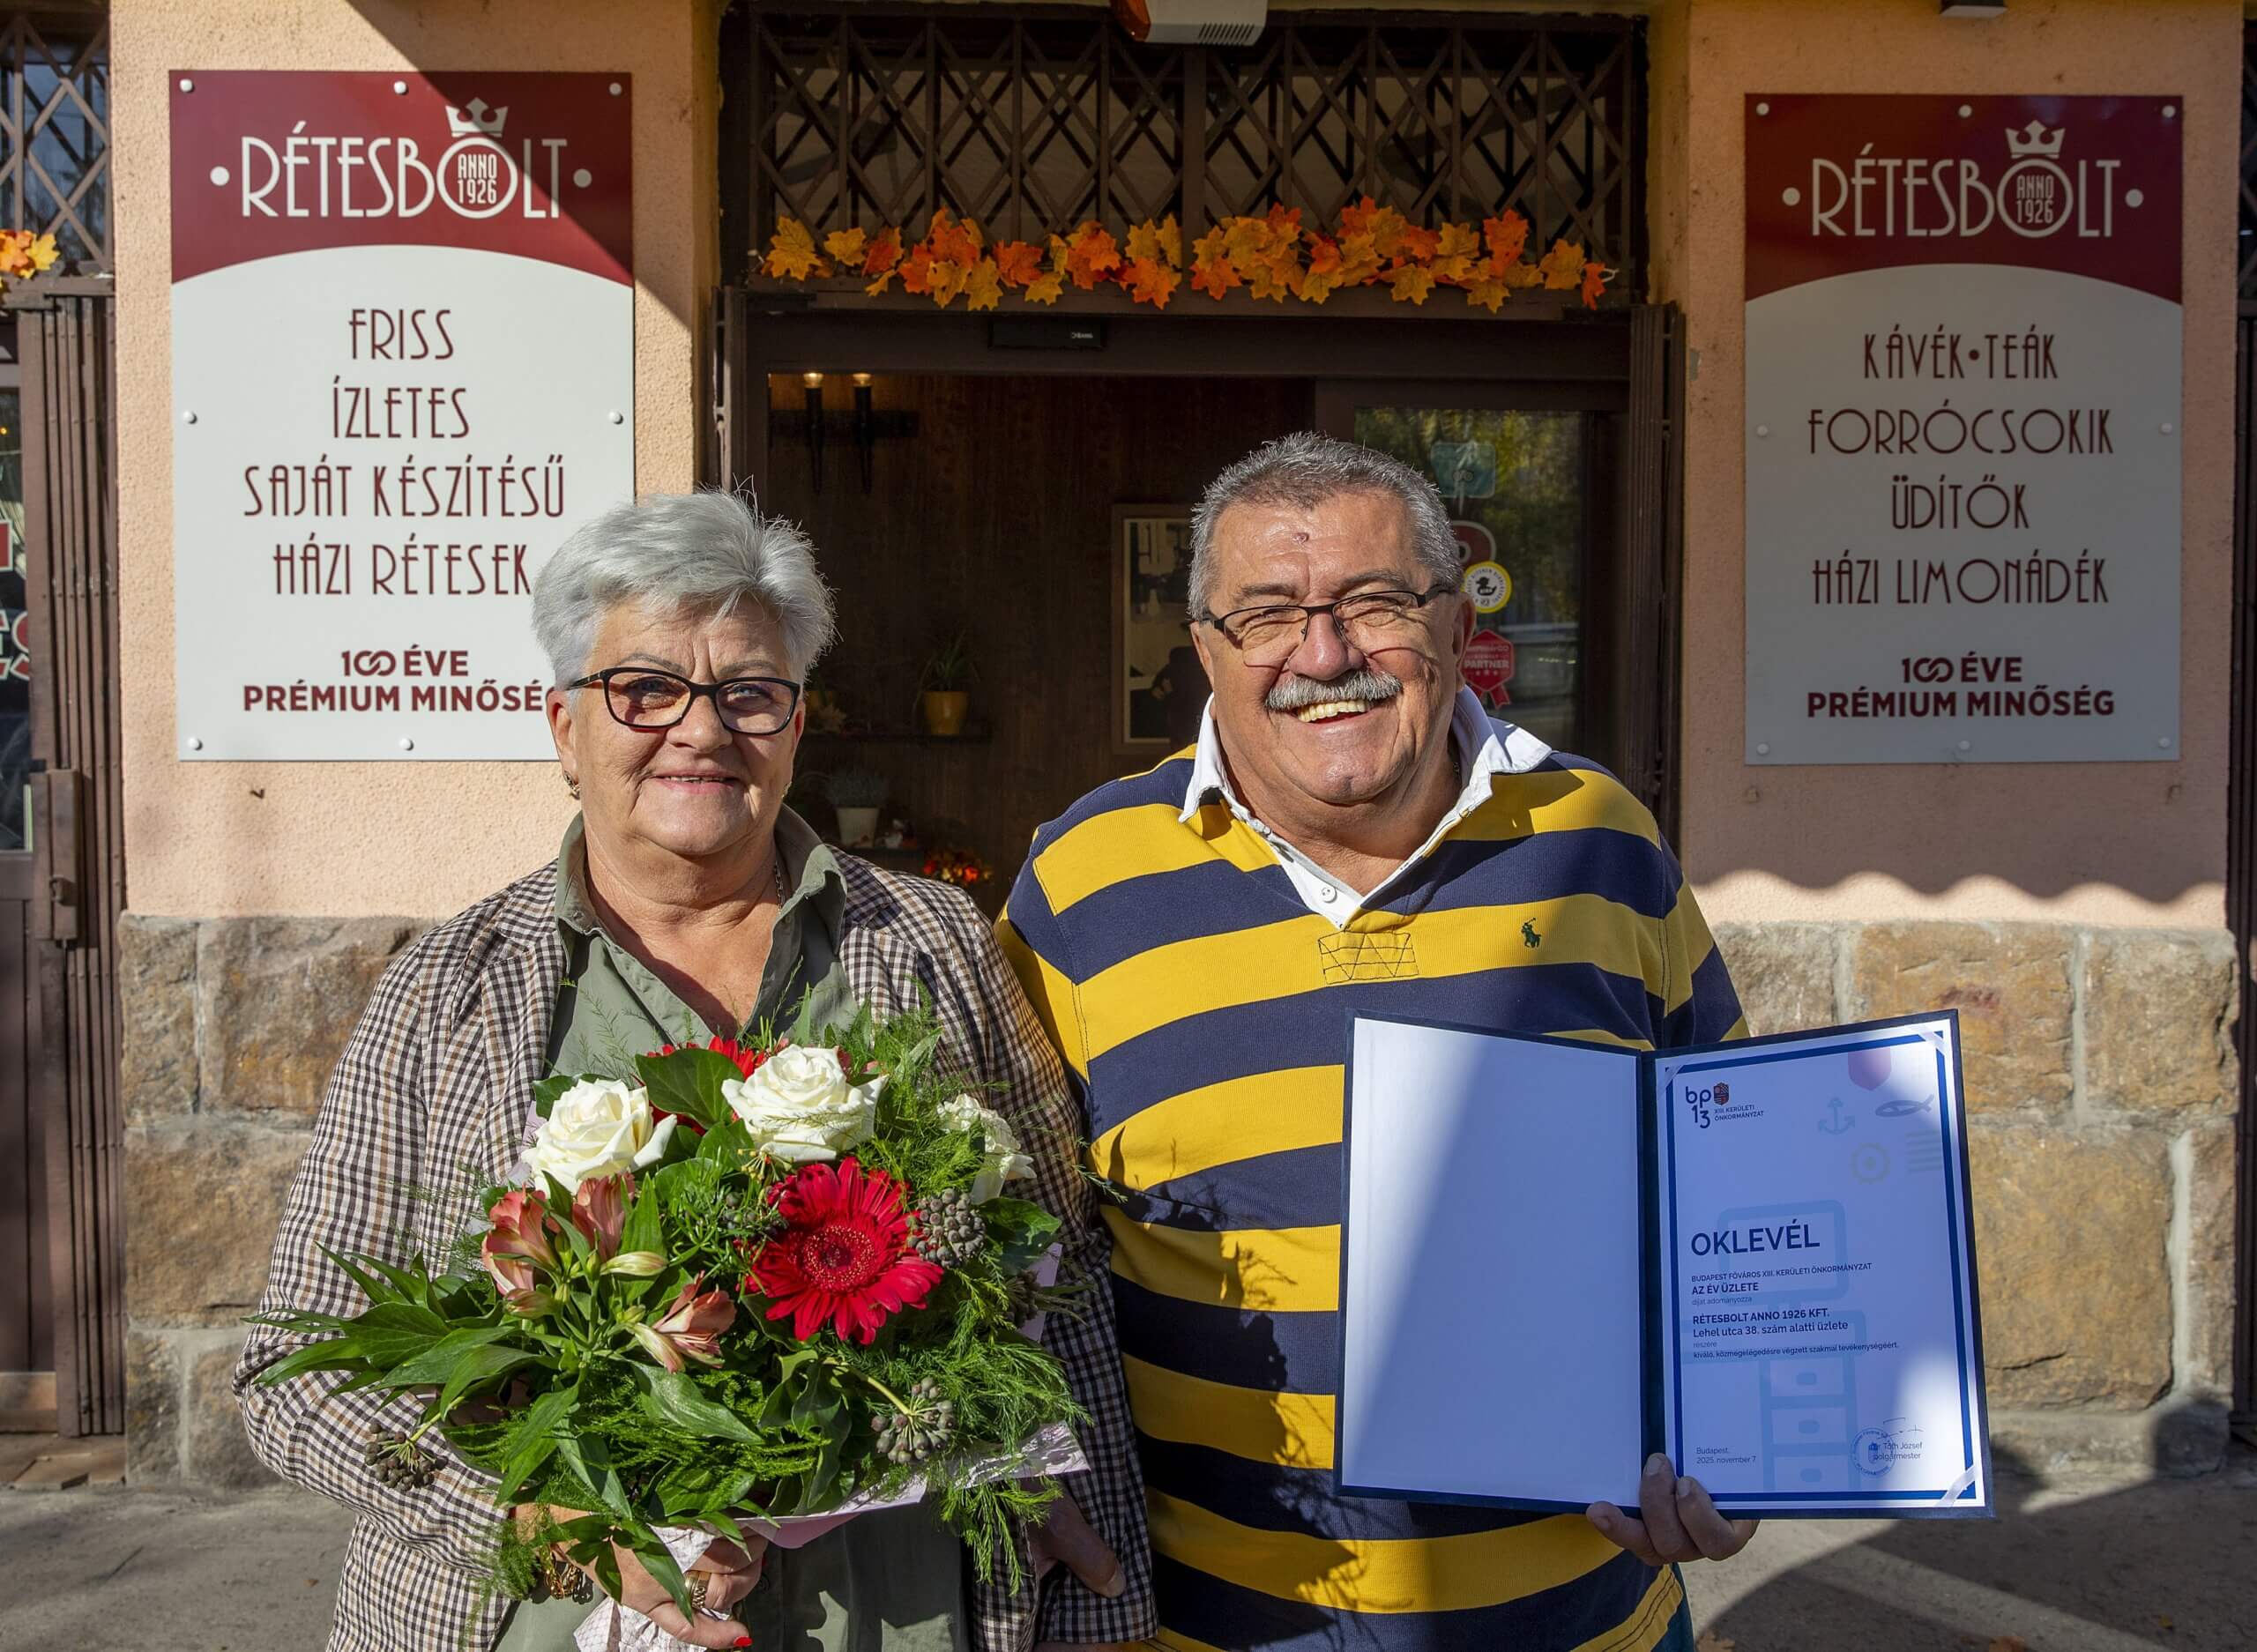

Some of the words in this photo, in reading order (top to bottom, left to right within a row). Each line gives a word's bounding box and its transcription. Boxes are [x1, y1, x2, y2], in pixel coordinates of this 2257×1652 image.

[242, 121, 567, 219] RÉTESBOLT
[458, 153, 497, 179] ANNO
[458, 180, 497, 204] 1926
[1812, 143, 2120, 238] RÉTESBOLT
[2016, 175, 2054, 199] ANNO
[2016, 200, 2053, 224] 1926
[348, 309, 454, 360] FRISS
[333, 376, 470, 439] ÍZLETES
[1808, 399, 2114, 454] FORRÓCSOKIK
[244, 454, 352, 517] SAJÁT
[374, 454, 564, 517] KÉSZÍTÉSŰ
[1892, 474, 2030, 529] ÜDÍTŐK
[272, 532, 350, 595] HÁZI
[373, 532, 531, 595] RÉTESEK
[1813, 549, 1879, 604] HÁZI
[1897, 549, 2108, 604] LIMONÁDÉK
[342, 651, 396, 676] 100
[404, 644, 468, 676] ÉVE
[1464, 659, 1510, 670] PARTNER
[1902, 658, 1954, 683] 100
[1961, 651, 2022, 683] ÉVE
[244, 679, 399, 711] PRÉMIUM
[411, 678, 555, 712] MINŐSÉ
[1808, 683, 1955, 718] PRÉMIUM
[1967, 683, 2115, 717] MINŐSÉG
[1685, 1085, 1712, 1108] bp
[1691, 1105, 1710, 1129] 13
[1691, 1218, 1821, 1256] OKLEVÉL
[1691, 1273, 1727, 1283] BUDAPEST
[1776, 1266, 1811, 1277] KERÜLETI
[1811, 1261, 1873, 1275] ÖNKORMÁNYZAT
[1692, 1285, 1705, 1295] AZ
[1707, 1283, 1719, 1294] ÉV
[1721, 1281, 1759, 1293] ÜZLETE
[1693, 1312, 1748, 1325] RÉTESBOLT
[1750, 1310, 1780, 1321] ANNO
[1782, 1309, 1806, 1320] 1926
[1808, 1307, 1830, 1318] KFT.
[1693, 1327, 1720, 1337] Lehel
[1721, 1327, 1743, 1336] utca
[1745, 1325, 1760, 1335] 38.
[1762, 1323, 1787, 1335] szám
[1789, 1321, 1815, 1333] alatti
[1817, 1320, 1849, 1331] üzlete
[1808, 1343, 1837, 1353] szakmai
[1716, 1455, 1749, 1464] november
